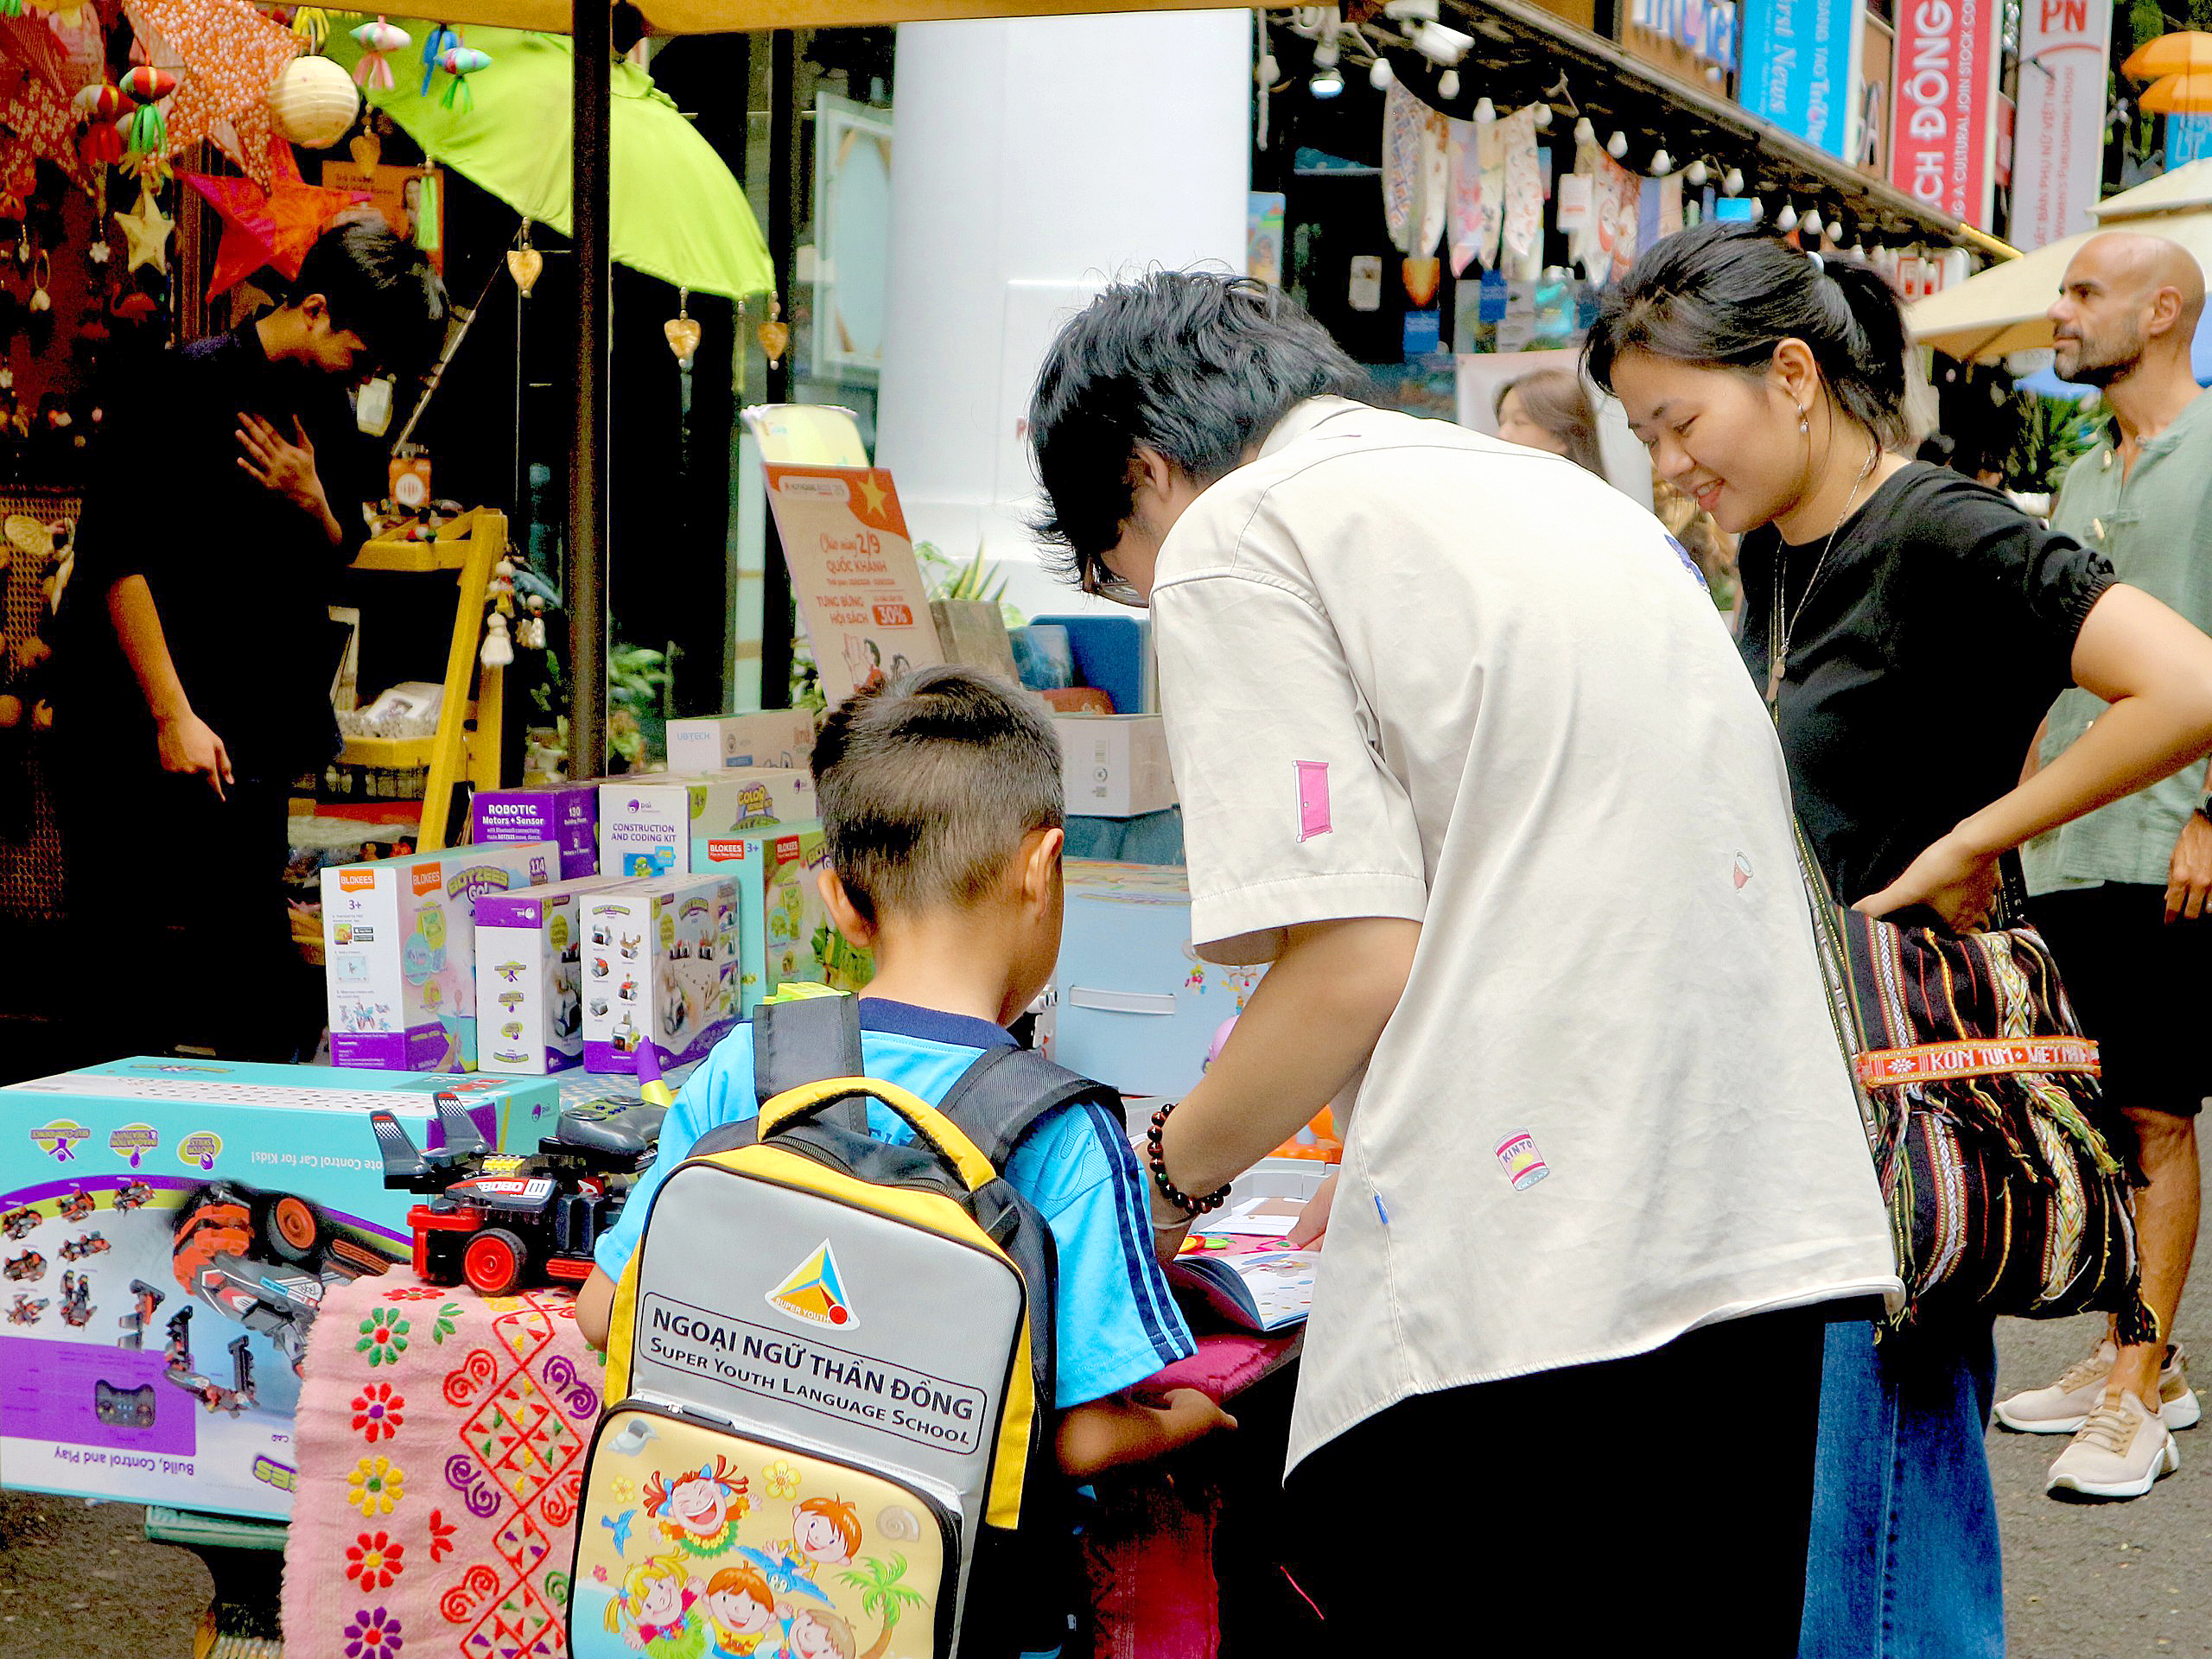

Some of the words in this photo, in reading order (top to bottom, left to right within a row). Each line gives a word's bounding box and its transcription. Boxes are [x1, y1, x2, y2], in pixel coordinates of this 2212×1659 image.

[1959, 29, 1974, 75] STOCK
[1903, 0, 1953, 140] ĐÔNG
[1770, 45, 1797, 114] News
[1958, 79, 1971, 111] JOIN
[1953, 116, 1970, 181] CULTURAL
[1913, 152, 1944, 207] CH
[857, 531, 880, 556] 2/9
[826, 556, 854, 574] QUỐC
[878, 605, 907, 623] 30%
[738, 785, 766, 806] COLOR
[488, 804, 537, 815] ROBOTIC
[516, 816, 544, 824] Sensor
[613, 823, 675, 833] CONSTRUCTION
[747, 843, 759, 852] 3+
[530, 857, 545, 872] 114
[340, 875, 373, 885] BLOKEES
[412, 871, 440, 886] BLOKEES
[348, 899, 361, 910] 3+
[1978, 1047, 2015, 1065] TUM
[251, 1152, 278, 1164] Kids!
[282, 1154, 297, 1166] for
[1502, 1140, 1533, 1163] KINTO
[300, 1156, 318, 1166] Car
[321, 1157, 362, 1170] Control
[365, 1160, 384, 1170] ote
[775, 1298, 801, 1314] SUPER
[802, 1309, 830, 1323] YOUTH
[652, 1307, 735, 1353] NGOẠI
[743, 1335, 807, 1369] NGỮ
[810, 1354, 885, 1395] THẦN
[891, 1376, 974, 1421] ĐỒNG
[54, 1446, 79, 1463] Play
[85, 1452, 106, 1465] and
[111, 1455, 156, 1471] Control
[159, 1458, 194, 1476] Build,
